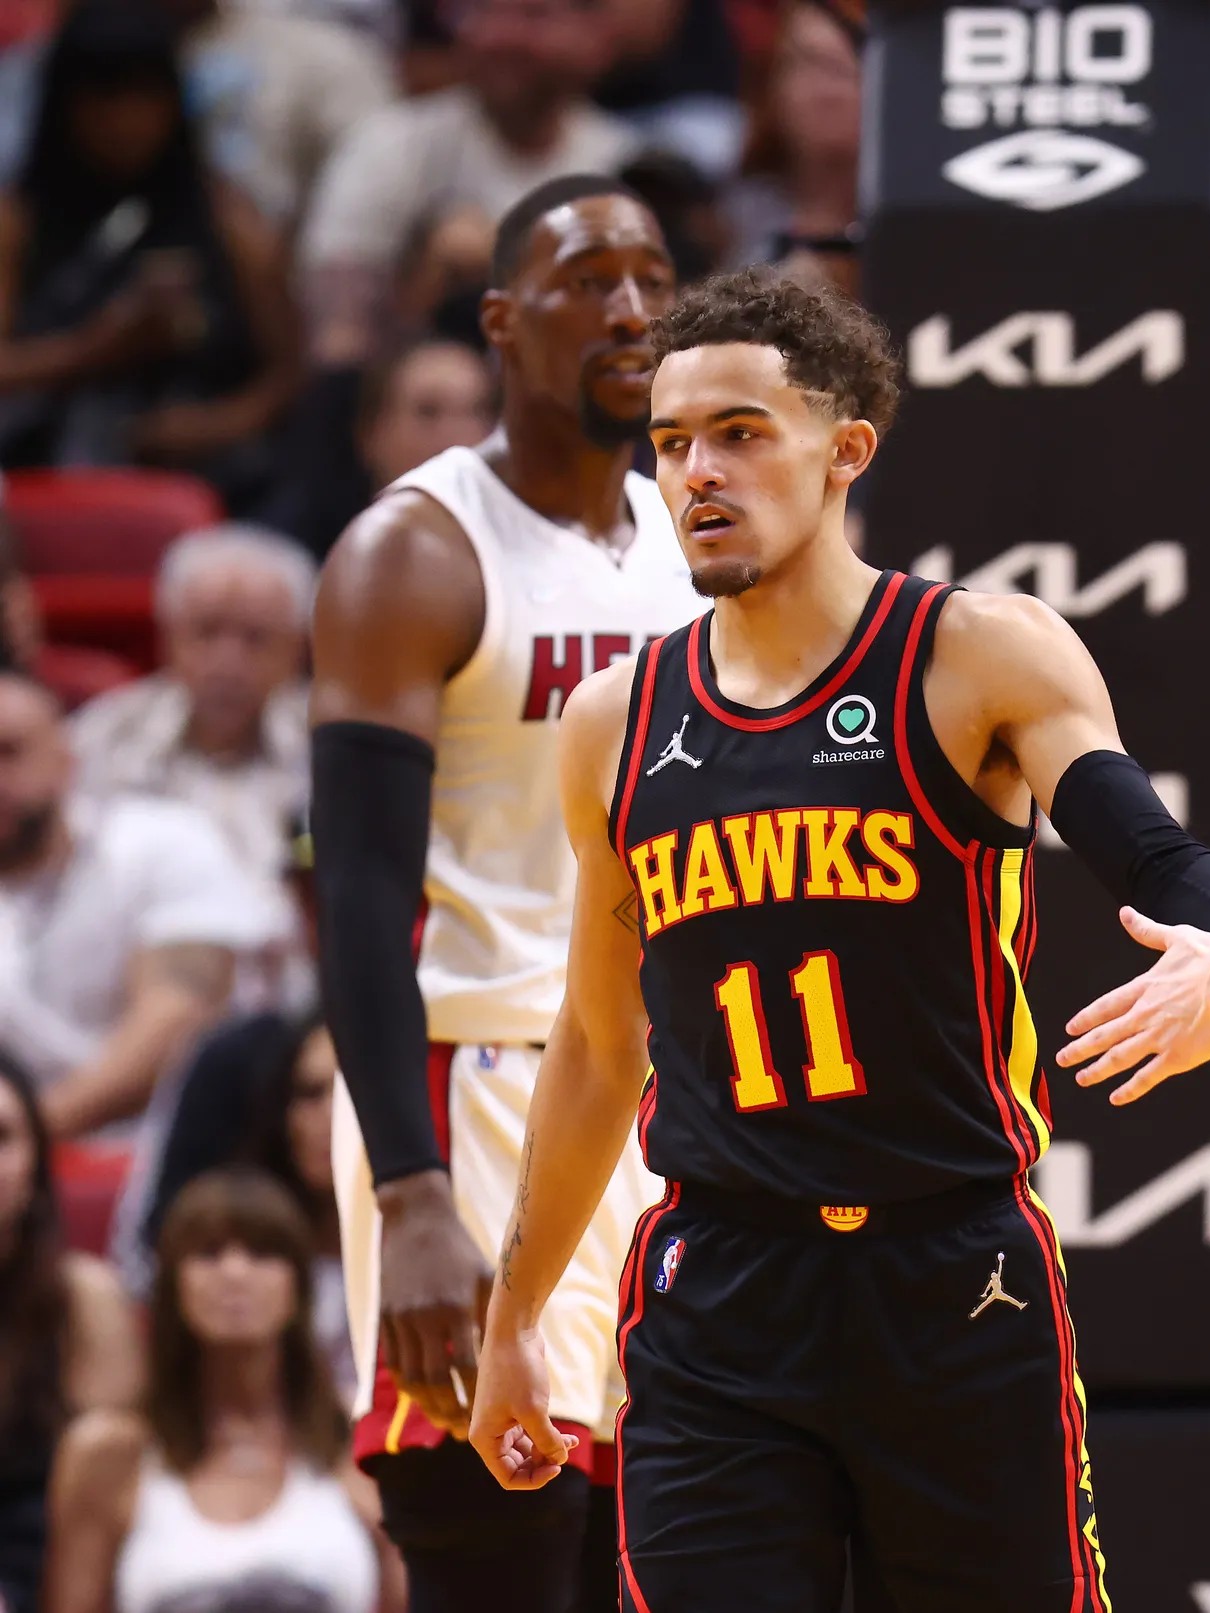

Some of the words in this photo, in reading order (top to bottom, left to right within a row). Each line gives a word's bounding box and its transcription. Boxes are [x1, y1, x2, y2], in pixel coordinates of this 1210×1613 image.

[942, 5, 1153, 84] BIO
[908, 310, 1185, 387] KIA
[812, 749, 885, 764] sharecare
[627, 806, 920, 940] HAWKS
[713, 948, 867, 1114] 11
